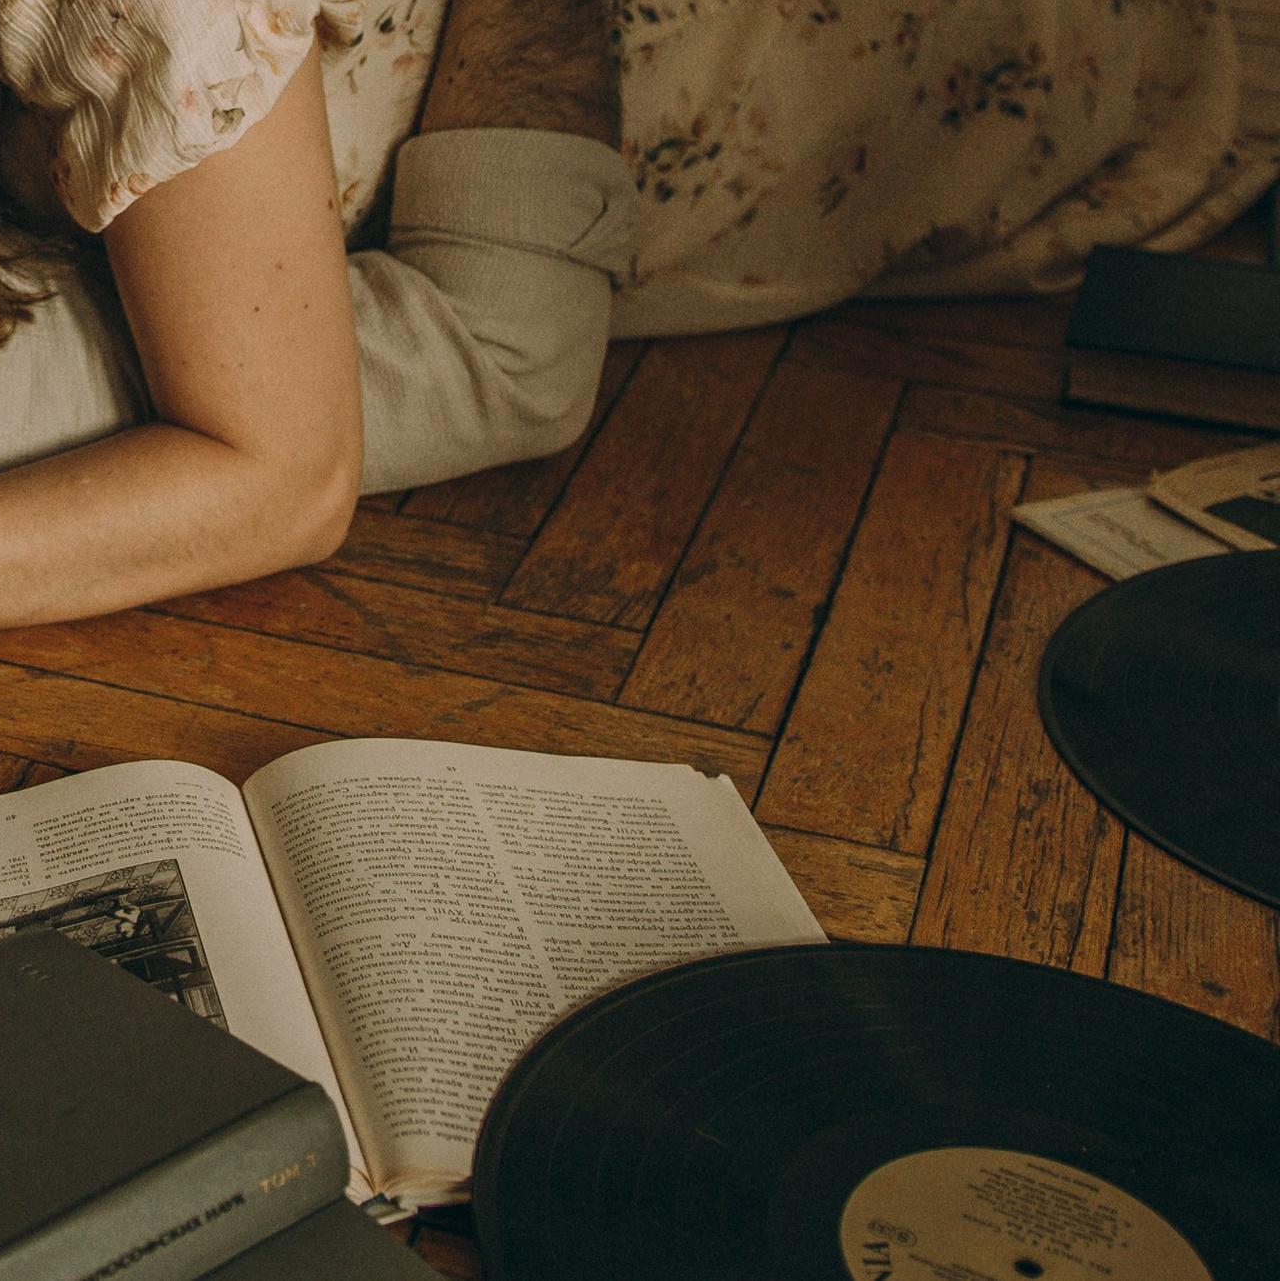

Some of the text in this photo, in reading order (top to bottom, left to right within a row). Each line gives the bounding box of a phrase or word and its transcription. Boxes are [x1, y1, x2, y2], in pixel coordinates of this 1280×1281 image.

[118, 805, 136, 813] как
[84, 816, 120, 829] только
[53, 826, 80, 837] лишь
[35, 835, 50, 843] бы
[134, 837, 173, 848] фигуру
[118, 849, 154, 860] можно
[418, 847, 446, 855] берет
[8, 855, 26, 863] 1791
[357, 854, 411, 863] подготовя
[415, 856, 457, 864] образом
[543, 853, 591, 862] карандаш
[608, 857, 662, 867] рейсфедер
[58, 857, 110, 876] увеличить
[294, 854, 340, 876] которого
[413, 864, 480, 874] копировании
[297, 860, 353, 883] живописец
[651, 867, 702, 875] скульптор
[454, 875, 505, 886] художник
[514, 874, 560, 884] портрете
[597, 874, 652, 882] изображен
[658, 875, 706, 883] Аргунова
[303, 878, 341, 899] разделе
[517, 883, 538, 892] Это
[455, 893, 513, 904] пированию
[521, 891, 581, 903] рейсфедера
[590, 898, 646, 906] описанием
[308, 890, 371, 915] упоминался
[334, 898, 407, 912] посвященные
[468, 902, 516, 913] занимали
[525, 901, 581, 911] полностью
[350, 907, 397, 917] большое
[433, 907, 464, 917] XVIII
[469, 910, 520, 922] искусству
[314, 915, 344, 931] место
[318, 914, 415, 939] изобразительному
[449, 917, 506, 929] литературе
[556, 922, 613, 930] изображен
[617, 924, 665, 933] Аргунова
[431, 932, 489, 945] художнику
[721, 931, 739, 939] дер
[323, 934, 382, 956] необходим
[358, 943, 383, 952] всех
[390, 940, 411, 949] Для
[502, 942, 532, 951] работ
[326, 950, 351, 965] этих
[479, 948, 521, 958] картона
